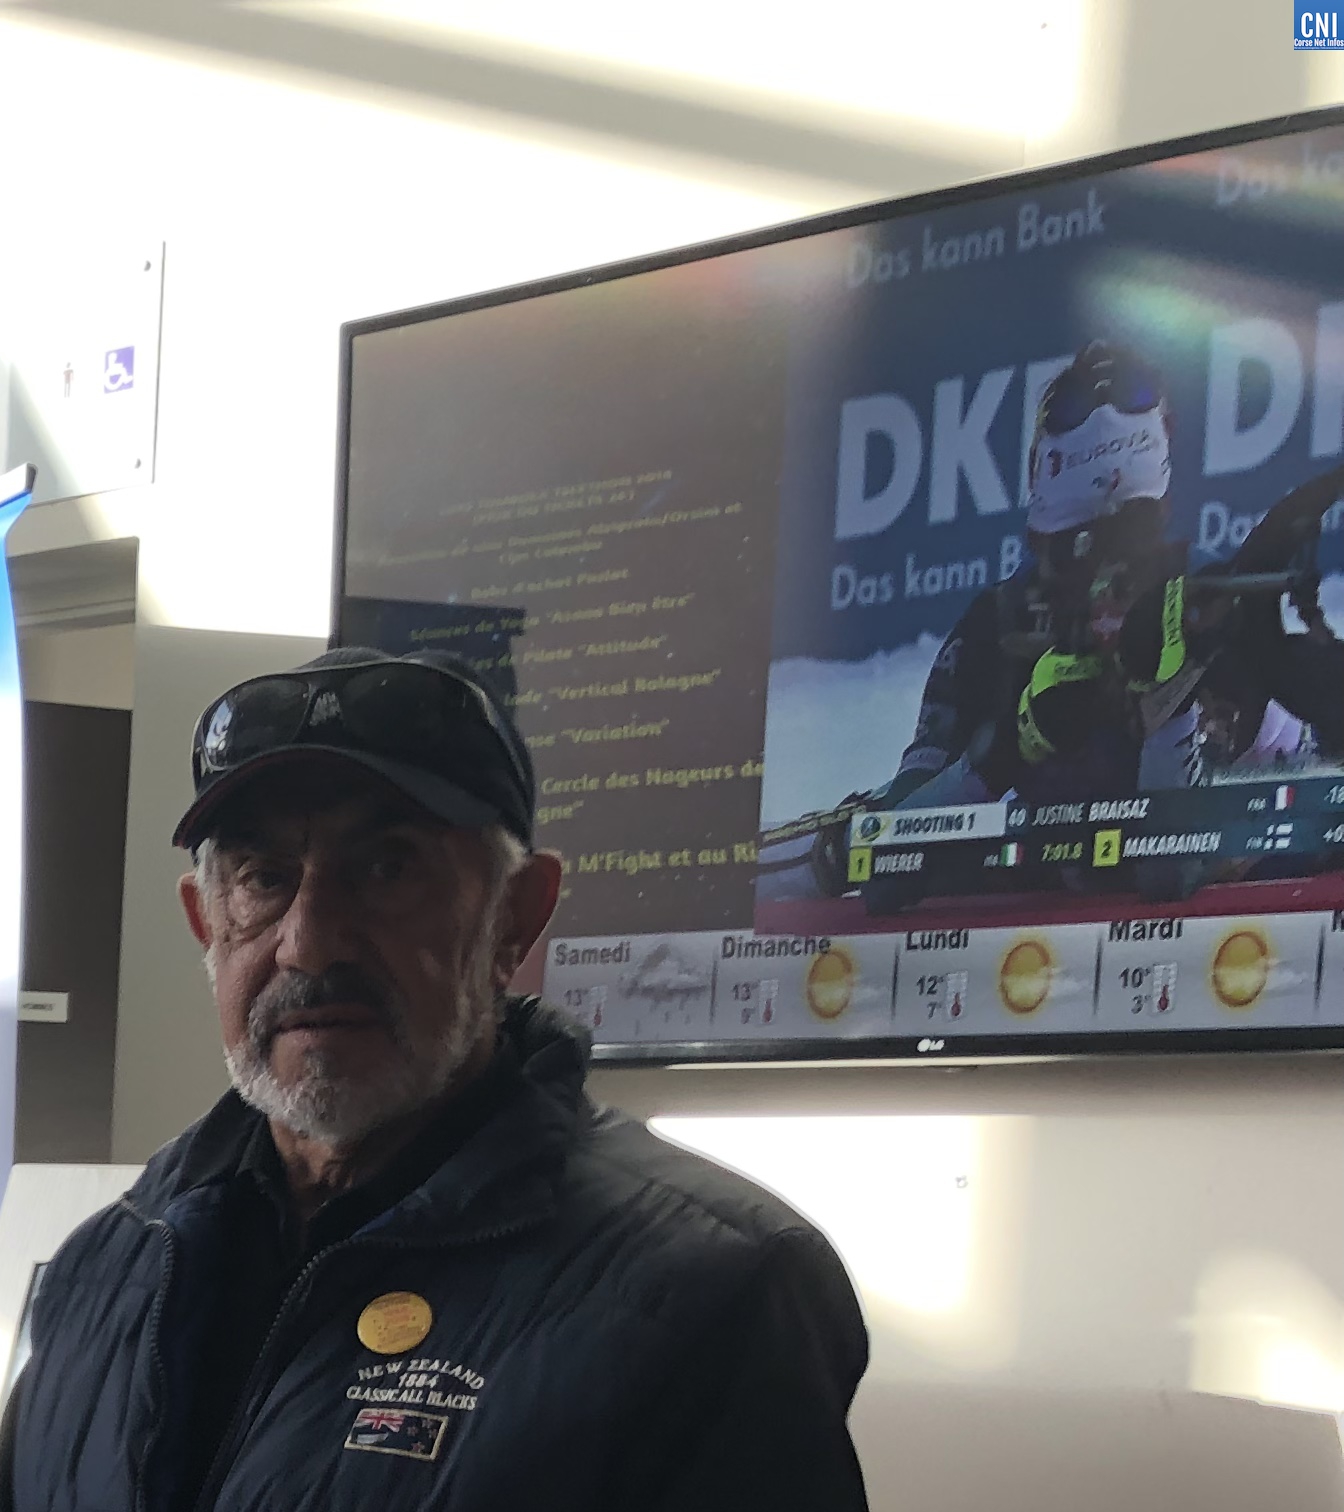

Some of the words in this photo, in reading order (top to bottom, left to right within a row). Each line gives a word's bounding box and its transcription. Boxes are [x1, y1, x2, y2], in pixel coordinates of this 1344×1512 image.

[847, 242, 911, 290] Das
[922, 225, 1004, 272] kann
[1018, 188, 1105, 252] Bank
[1197, 500, 1265, 552] Da
[831, 566, 892, 611] Das
[905, 553, 987, 598] kann
[560, 718, 671, 745] "Variation"
[540, 776, 600, 796] Cercle
[604, 771, 640, 790] des
[644, 764, 734, 789] Nageurs
[891, 813, 961, 838] SHOOTING
[964, 812, 975, 832] 1
[1031, 802, 1085, 827] JUSTINE
[1087, 797, 1150, 822] BRAISAZ
[667, 847, 692, 868] et
[697, 846, 727, 866] au
[1122, 830, 1223, 859] MAKARAINEN
[873, 851, 925, 875] WIERER
[905, 929, 970, 952] Lundi
[1108, 918, 1185, 943] Mardi
[554, 941, 632, 967] Samedi
[720, 935, 832, 960] Dimanche
[357, 1359, 405, 1382] NEW
[407, 1357, 486, 1391] ZEALAND
[397, 1373, 441, 1389] 1884
[426, 1390, 478, 1411] BLACKS
